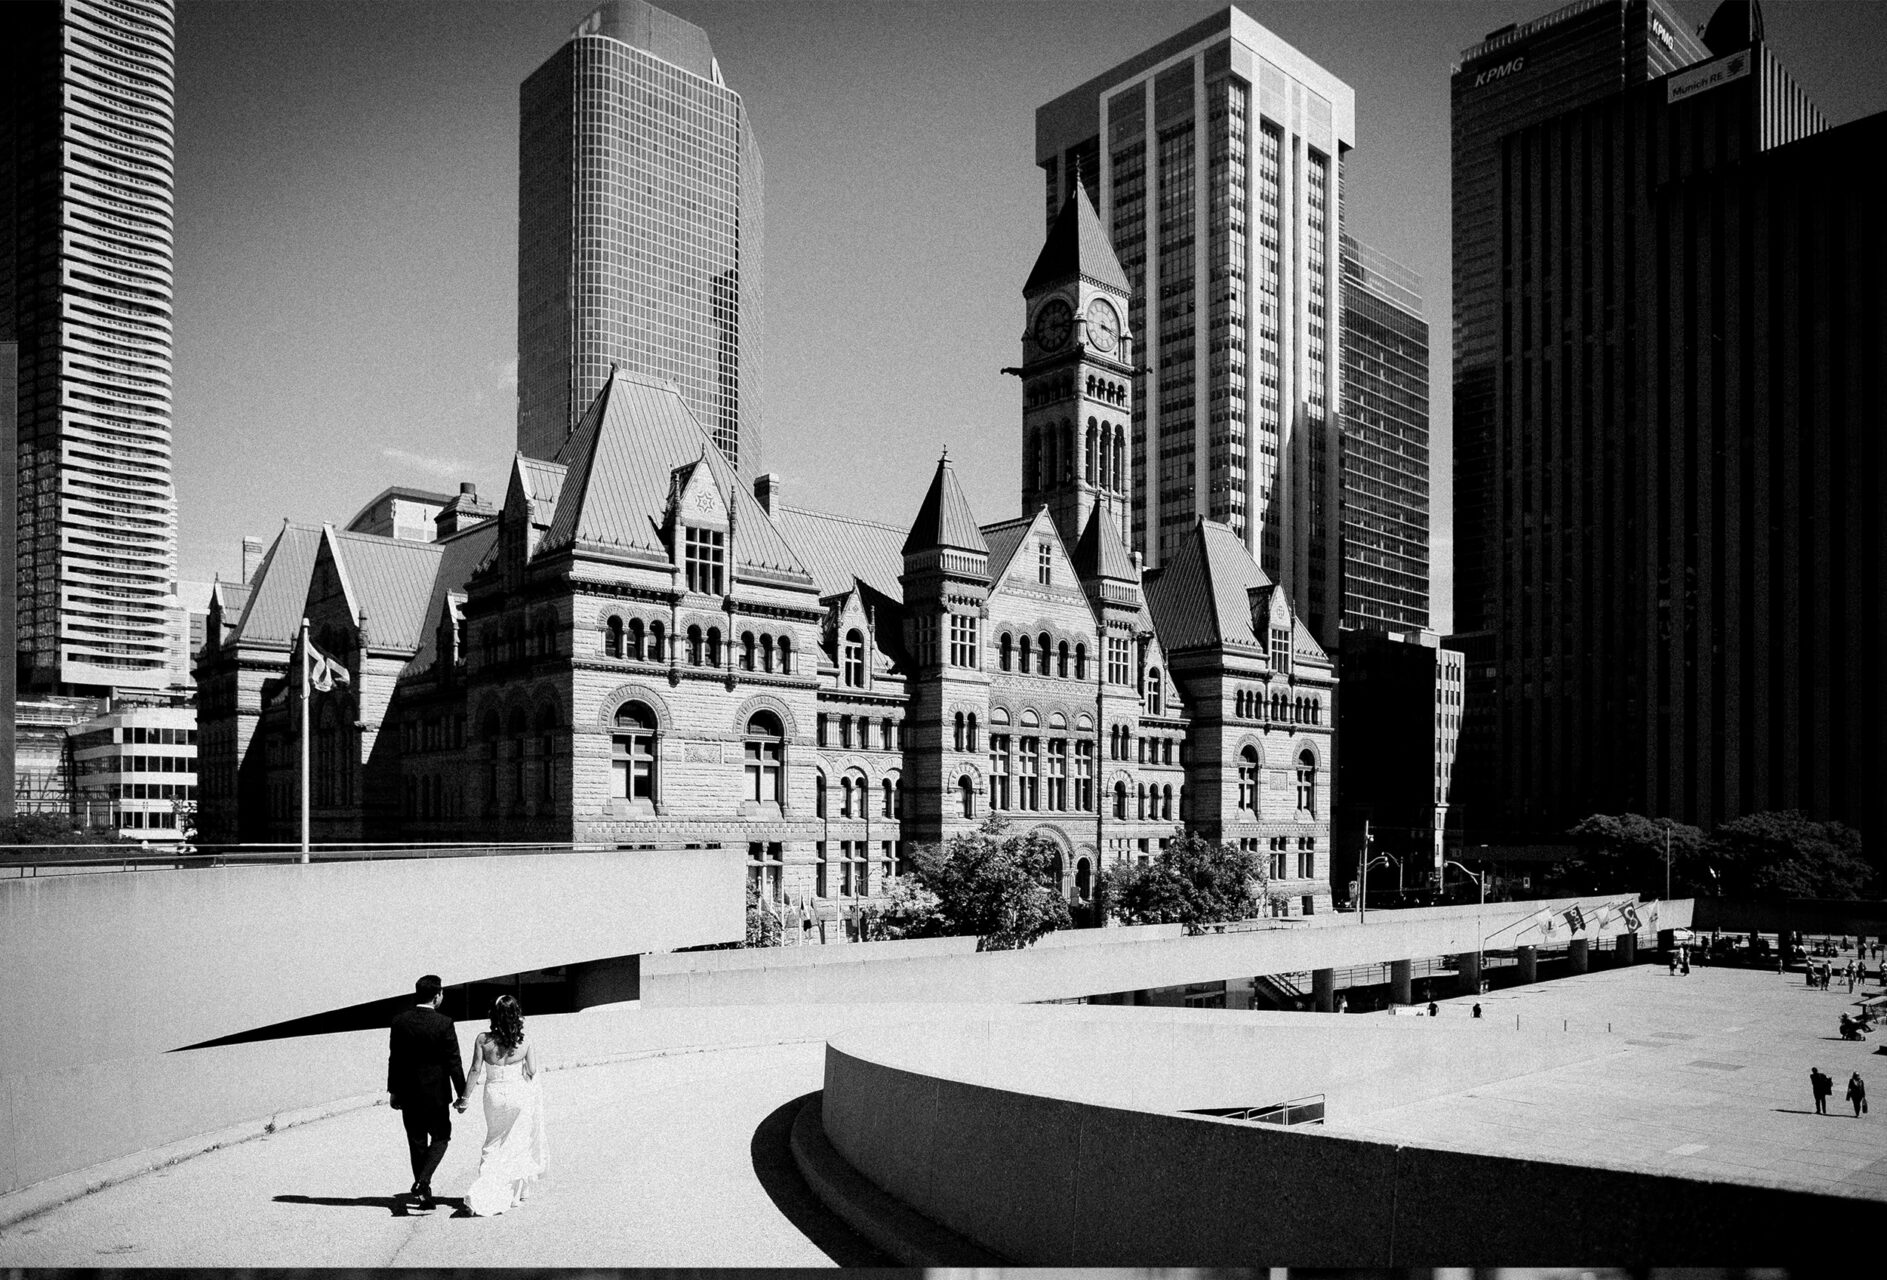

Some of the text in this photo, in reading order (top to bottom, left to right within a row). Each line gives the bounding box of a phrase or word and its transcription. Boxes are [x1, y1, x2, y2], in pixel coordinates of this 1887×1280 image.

[1653, 19, 1673, 50] KPMG
[1475, 56, 1524, 87] KPMG
[1673, 72, 1722, 96] Munich RE
